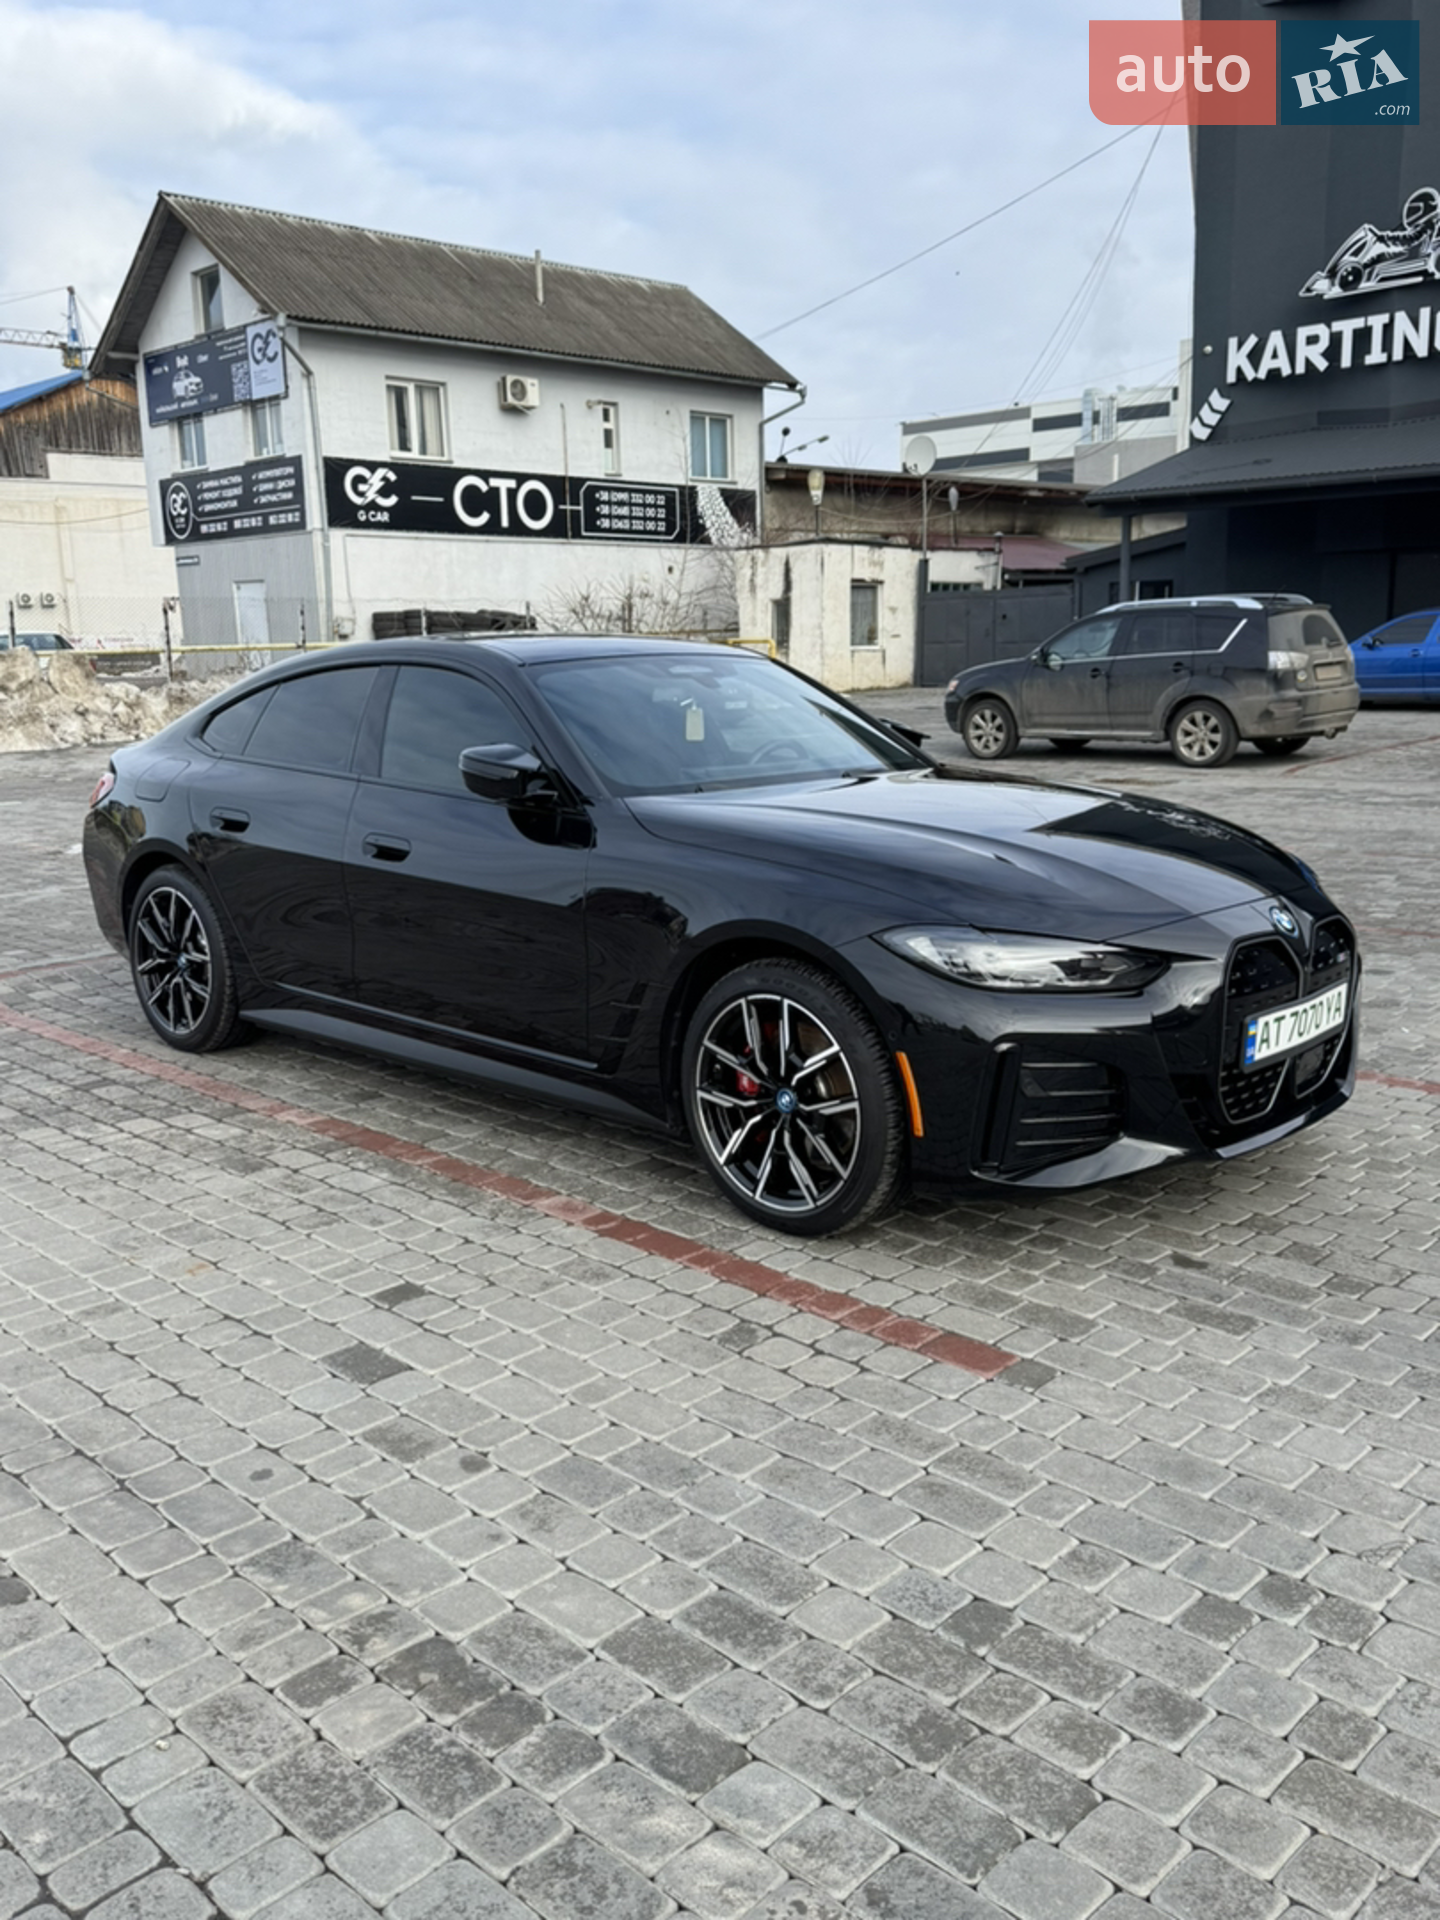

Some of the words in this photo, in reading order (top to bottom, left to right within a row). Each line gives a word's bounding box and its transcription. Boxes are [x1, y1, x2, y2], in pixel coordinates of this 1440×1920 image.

[1226, 305, 1440, 385] KARTIN
[357, 509, 367, 522] G
[367, 510, 391, 523] CAR
[453, 474, 554, 531] СТО
[1258, 1014, 1287, 1054] AT
[1287, 1000, 1324, 1043] 7070
